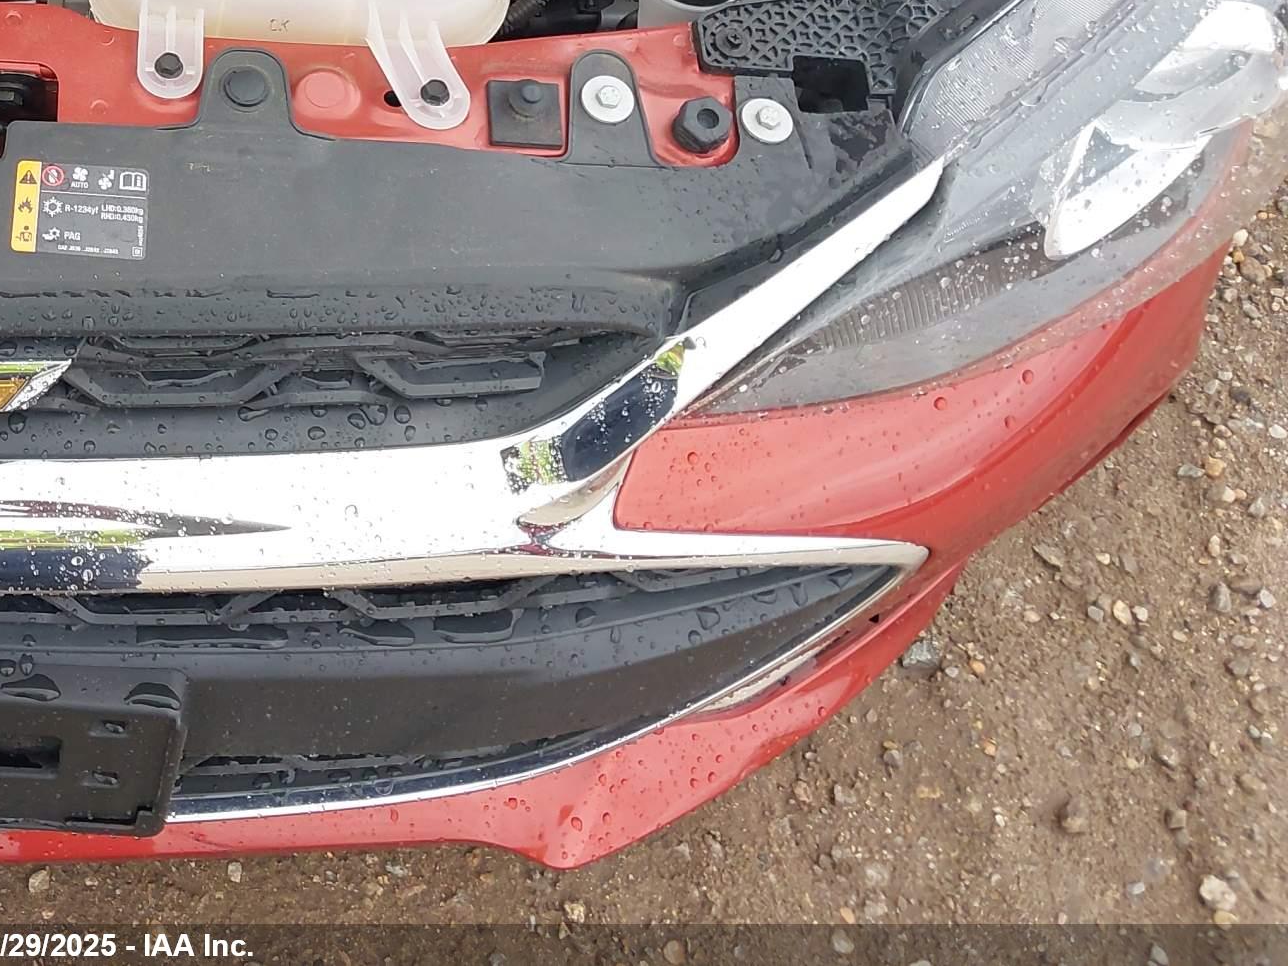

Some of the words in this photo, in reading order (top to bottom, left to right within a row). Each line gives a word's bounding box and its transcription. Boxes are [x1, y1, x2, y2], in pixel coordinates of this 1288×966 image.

[71, 181, 89, 189] AUTO
[64, 204, 99, 215] R-1234yf
[64, 231, 81, 241] PAG
